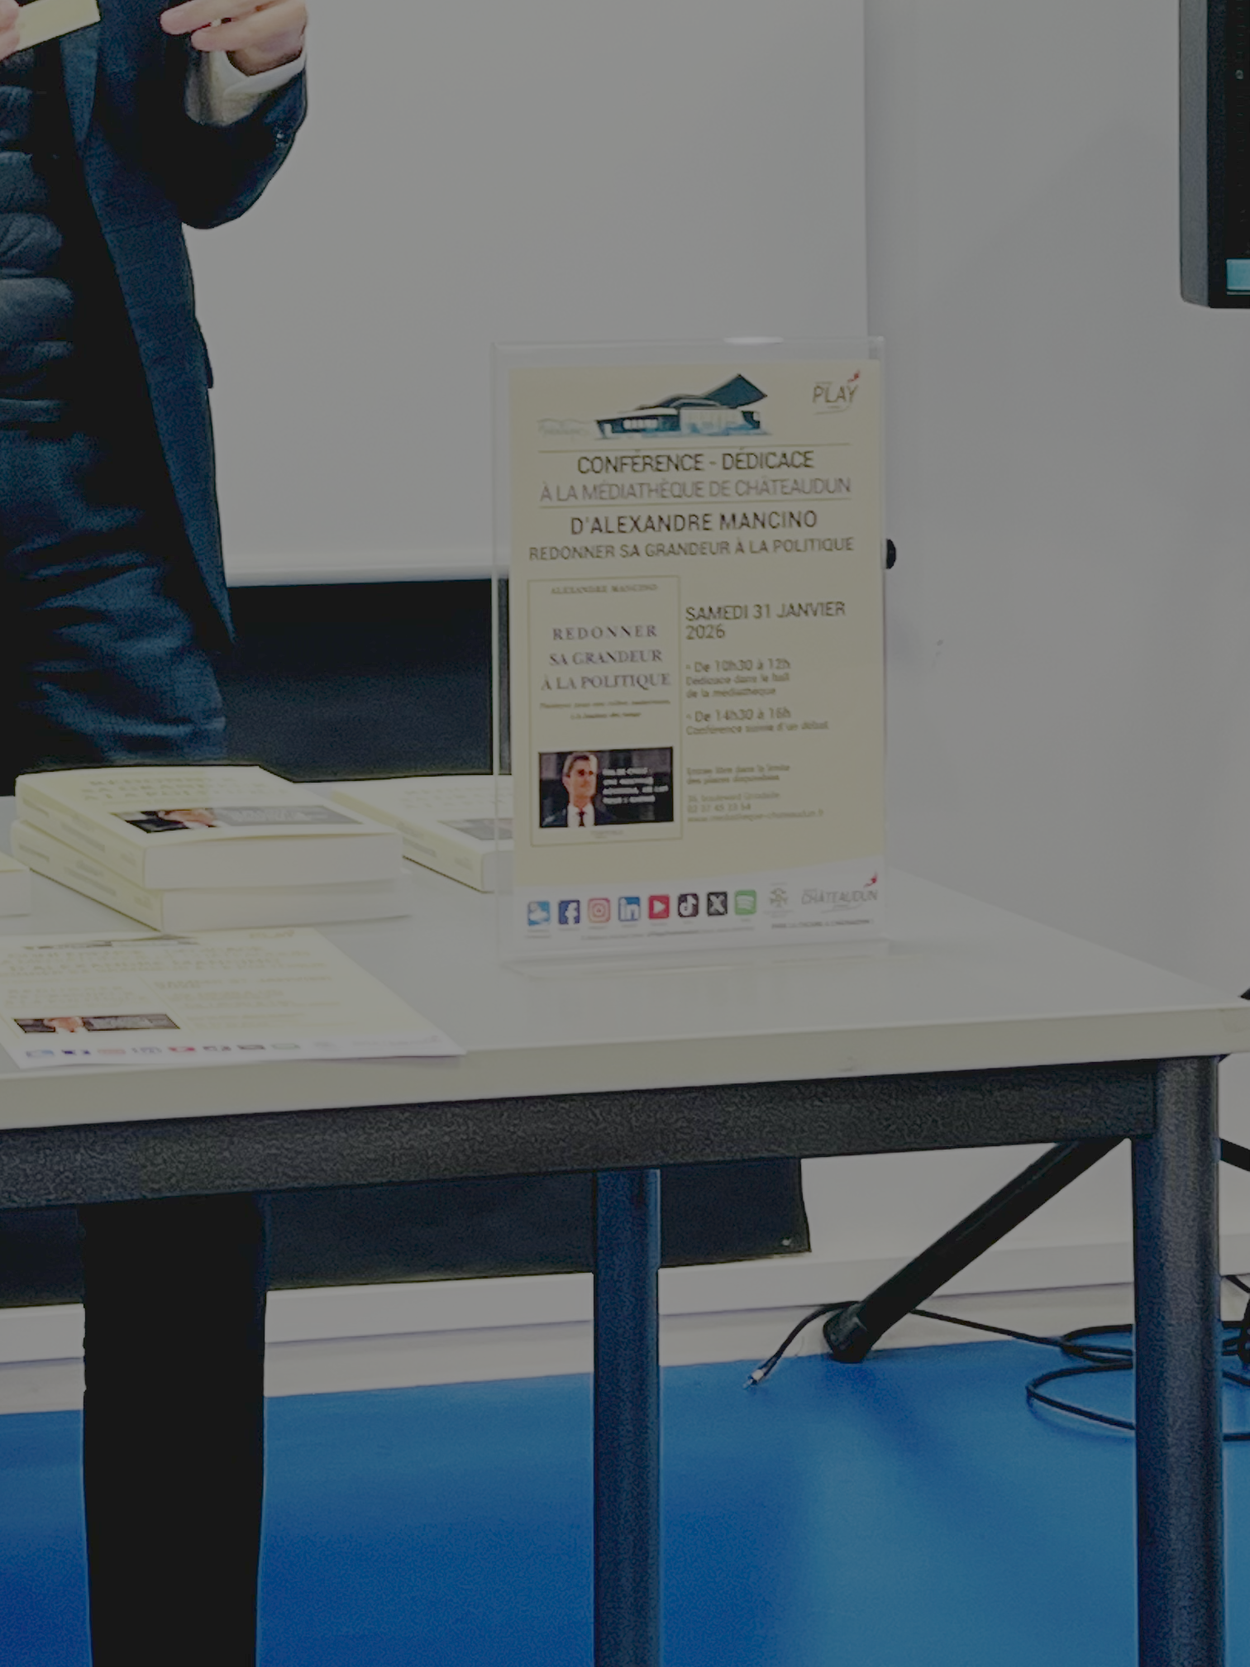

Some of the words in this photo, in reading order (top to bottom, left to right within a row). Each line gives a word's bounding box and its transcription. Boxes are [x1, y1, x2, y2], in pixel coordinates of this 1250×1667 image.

[812, 384, 859, 403] PLAY
[578, 448, 703, 474] CONFÉRENCE
[722, 447, 814, 470] DÉDICACE
[540, 480, 553, 502] À
[557, 485, 578, 502] LA
[582, 478, 706, 501] MÉDIATHÈQUE
[709, 480, 732, 498] DE
[735, 476, 851, 497] CHÂTEAUDUN
[571, 512, 713, 535] D'ALEXANDRE
[720, 510, 818, 531] MANCINO
[529, 544, 616, 561] REDONNER
[620, 542, 641, 558] SA
[644, 540, 730, 557] GRANDEUR
[735, 537, 745, 554] À
[749, 539, 769, 554] LA
[773, 537, 854, 553] POLITIQUE
[685, 605, 748, 621] SAMEDI
[753, 603, 771, 619] 31
[776, 600, 846, 618] JANVIER
[552, 624, 658, 642] REDONNER
[685, 624, 726, 640] 2026
[549, 651, 570, 667] SA
[573, 649, 663, 666] GRANDEUR
[694, 662, 711, 673] De
[541, 672, 553, 691] À
[556, 675, 578, 691] LA
[580, 672, 672, 690] POLITIQUE
[694, 710, 711, 722] De
